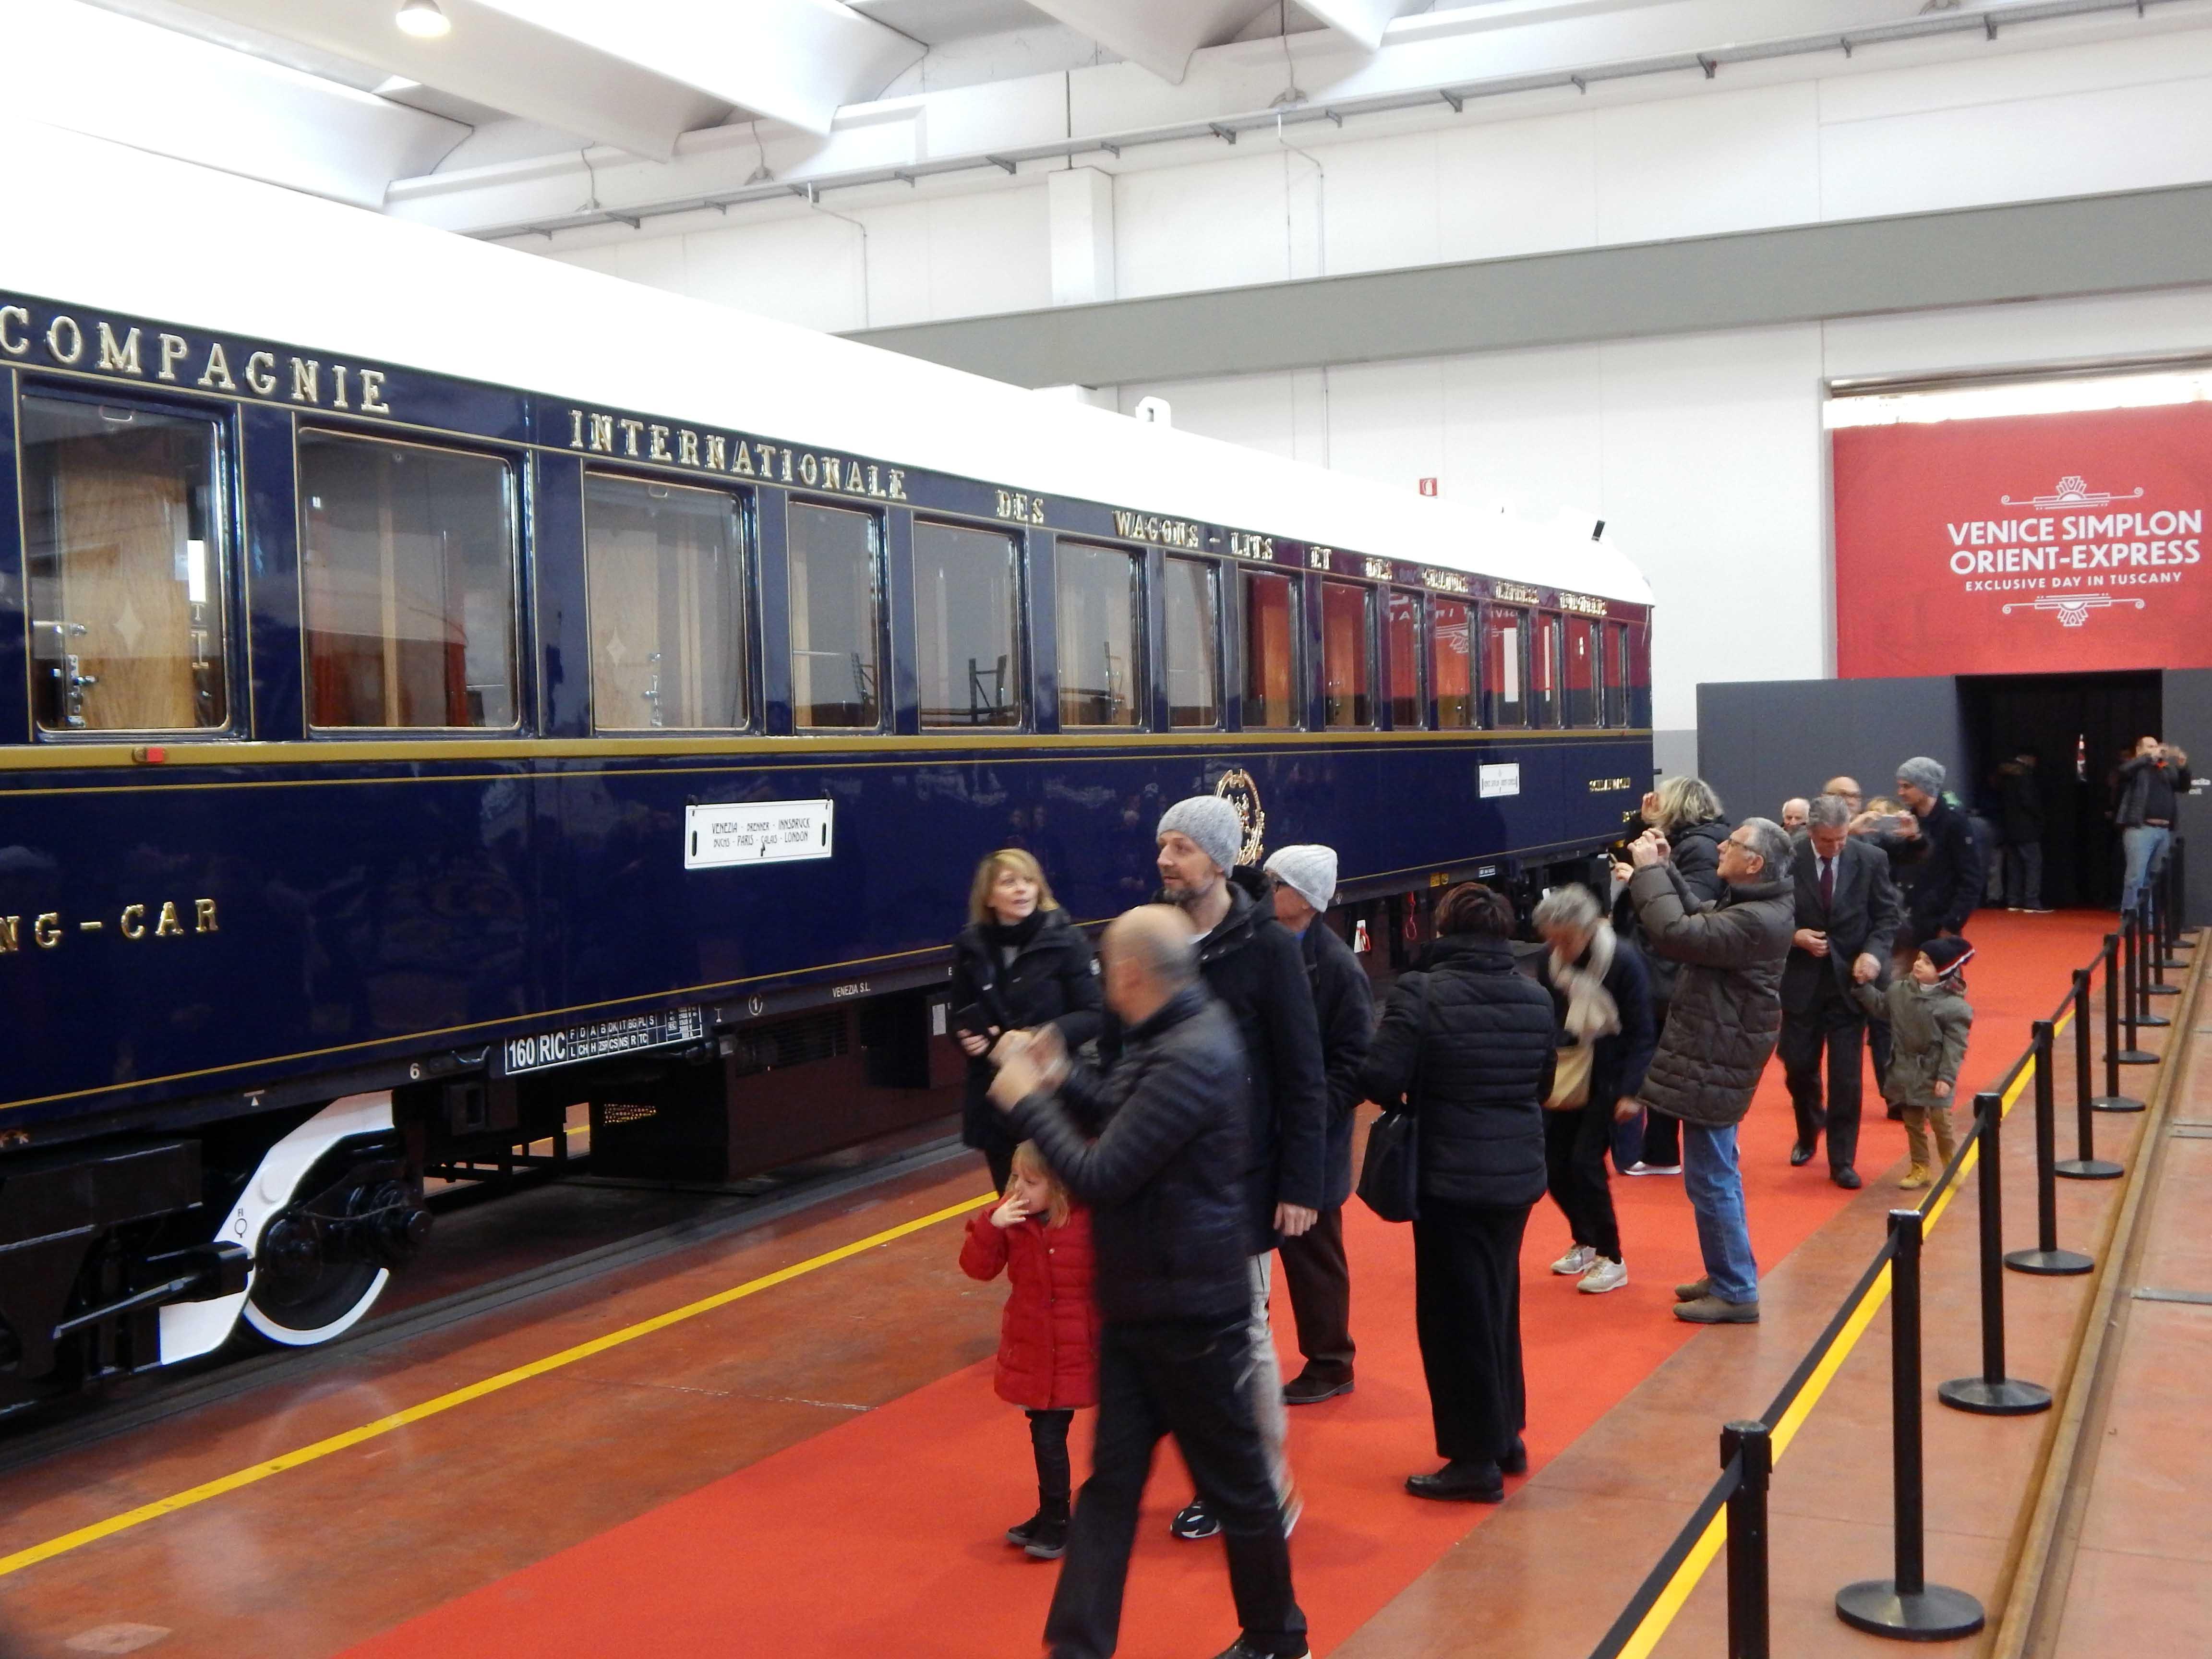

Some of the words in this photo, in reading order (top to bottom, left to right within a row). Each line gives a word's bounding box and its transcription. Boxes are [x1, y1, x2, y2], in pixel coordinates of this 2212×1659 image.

[0, 305, 389, 414] COMPAGNIE
[568, 409, 907, 500] INTERNATIONALE
[995, 490, 1044, 524] DES
[1947, 517, 2055, 546] VENICE
[2062, 509, 2202, 541] SIMPLON
[1950, 539, 2201, 575] ORIENT-EXPRESS
[1966, 577, 2046, 592] EXCLUSIVE
[2052, 577, 2082, 588] DAY
[2088, 576, 2104, 586] IN
[2110, 572, 2182, 585] TUSCANY
[711, 822, 737, 834] VENEZIA
[737, 834, 754, 846] PARIS
[784, 830, 808, 843] LONDON
[832, 984, 858, 998] VENEZIA
[570, 1029, 576, 1039] F
[580, 1027, 586, 1037] D
[590, 1025, 597, 1036] A
[649, 1015, 654, 1025] S
[510, 1036, 536, 1068] 160
[540, 1032, 565, 1063] RIC
[570, 1046, 576, 1057] L
[578, 1044, 588, 1055] CH
[591, 1043, 597, 1053] H
[609, 1038, 618, 1049] CS
[630, 1035, 636, 1046] R
[409, 1063, 420, 1079] 6
